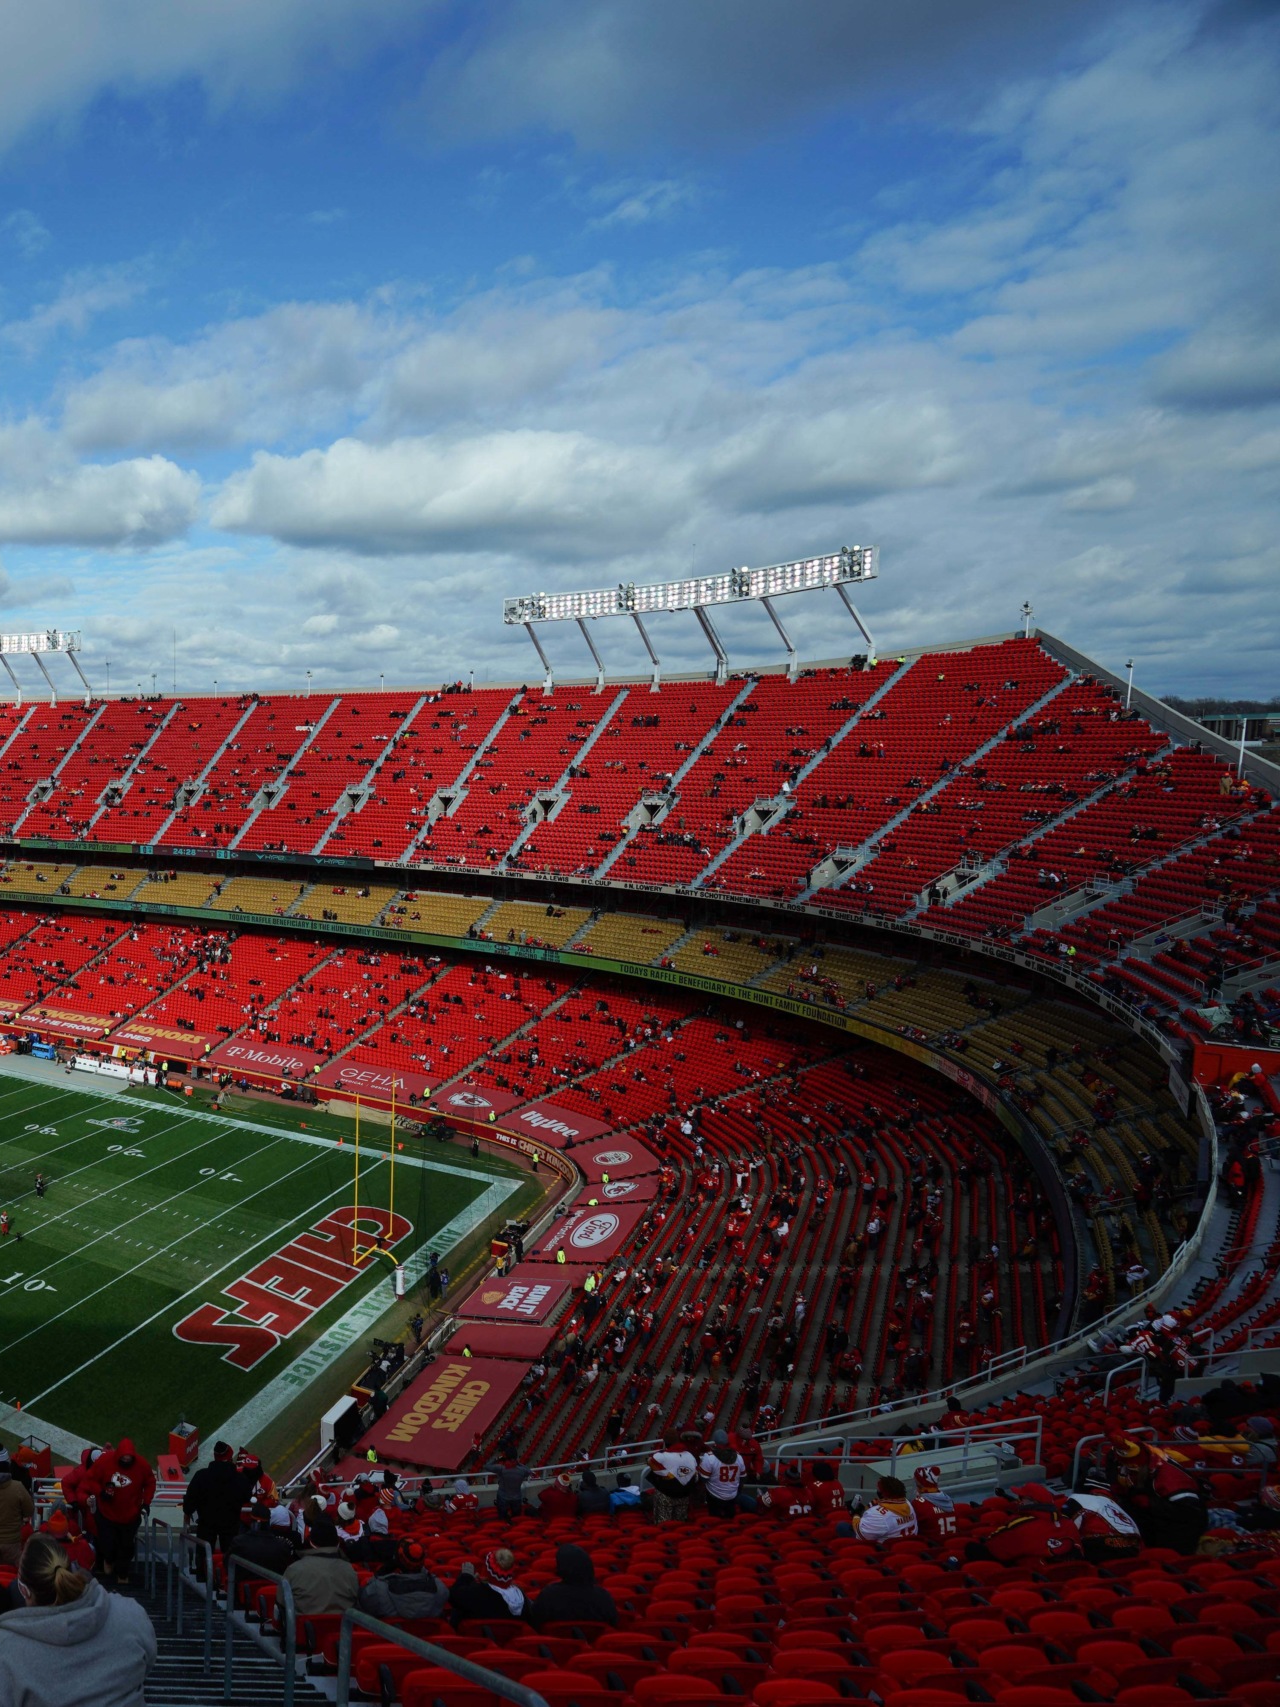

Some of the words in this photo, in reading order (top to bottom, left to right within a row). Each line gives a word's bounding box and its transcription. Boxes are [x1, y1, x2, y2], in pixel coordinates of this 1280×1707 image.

[173, 848, 196, 856] 24:28
[448, 866, 480, 874] STEADMAN
[636, 884, 663, 892] LOWERY
[675, 889, 698, 897] MARTY
[700, 891, 760, 905] SCHOTTENHEIMER
[787, 904, 806, 912] ROSS
[835, 912, 864, 923] SHIELDS
[229, 913, 250, 922] TODAYS
[251, 916, 271, 924] RAFFLE
[272, 918, 309, 928] BENEFICIARY
[319, 923, 330, 931] THE
[331, 925, 348, 933] HUNT
[348, 926, 370, 935] FAMILY
[372, 929, 412, 940] FOUNDATION
[891, 923, 922, 936] BARBARO
[946, 936, 972, 948] HOLMES
[996, 949, 1016, 962] GREEN
[620, 964, 648, 976] TODAYS
[650, 970, 677, 982] RAFFLE
[679, 976, 726, 993] BENEFICIARY
[728, 986, 735, 996] IS
[738, 988, 751, 999] THE
[753, 992, 773, 1005] HUNT
[775, 998, 801, 1013] FAMILY
[802, 1005, 847, 1028] FOUNDATION
[21, 1015, 36, 1023] ON
[40, 1018, 63, 1029] THE
[62, 1022, 102, 1033] FRONT
[28, 1007, 115, 1027] KINGDOM
[116, 1032, 152, 1043] LINES
[124, 1024, 206, 1044] HONORS
[243, 1049, 304, 1070] Mobile
[340, 1068, 406, 1090] GEHA
[520, 1110, 580, 1138] HyVee
[496, 1132, 511, 1143] THIS
[510, 1137, 518, 1146] IS
[518, 1140, 546, 1161] CHIEFS
[199, 1167, 236, 1181] 10
[0, 1271, 46, 1292] 10
[172, 1206, 414, 1372] CHIEFS
[497, 1286, 530, 1311] BACK
[527, 1284, 552, 1305] RUN
[280, 1321, 359, 1387] JUSTICE
[385, 1363, 472, 1442] KINGDOM
[431, 1380, 491, 1432] CHIEFS
[718, 1466, 737, 1483] 87
[934, 1516, 953, 1535] 15
